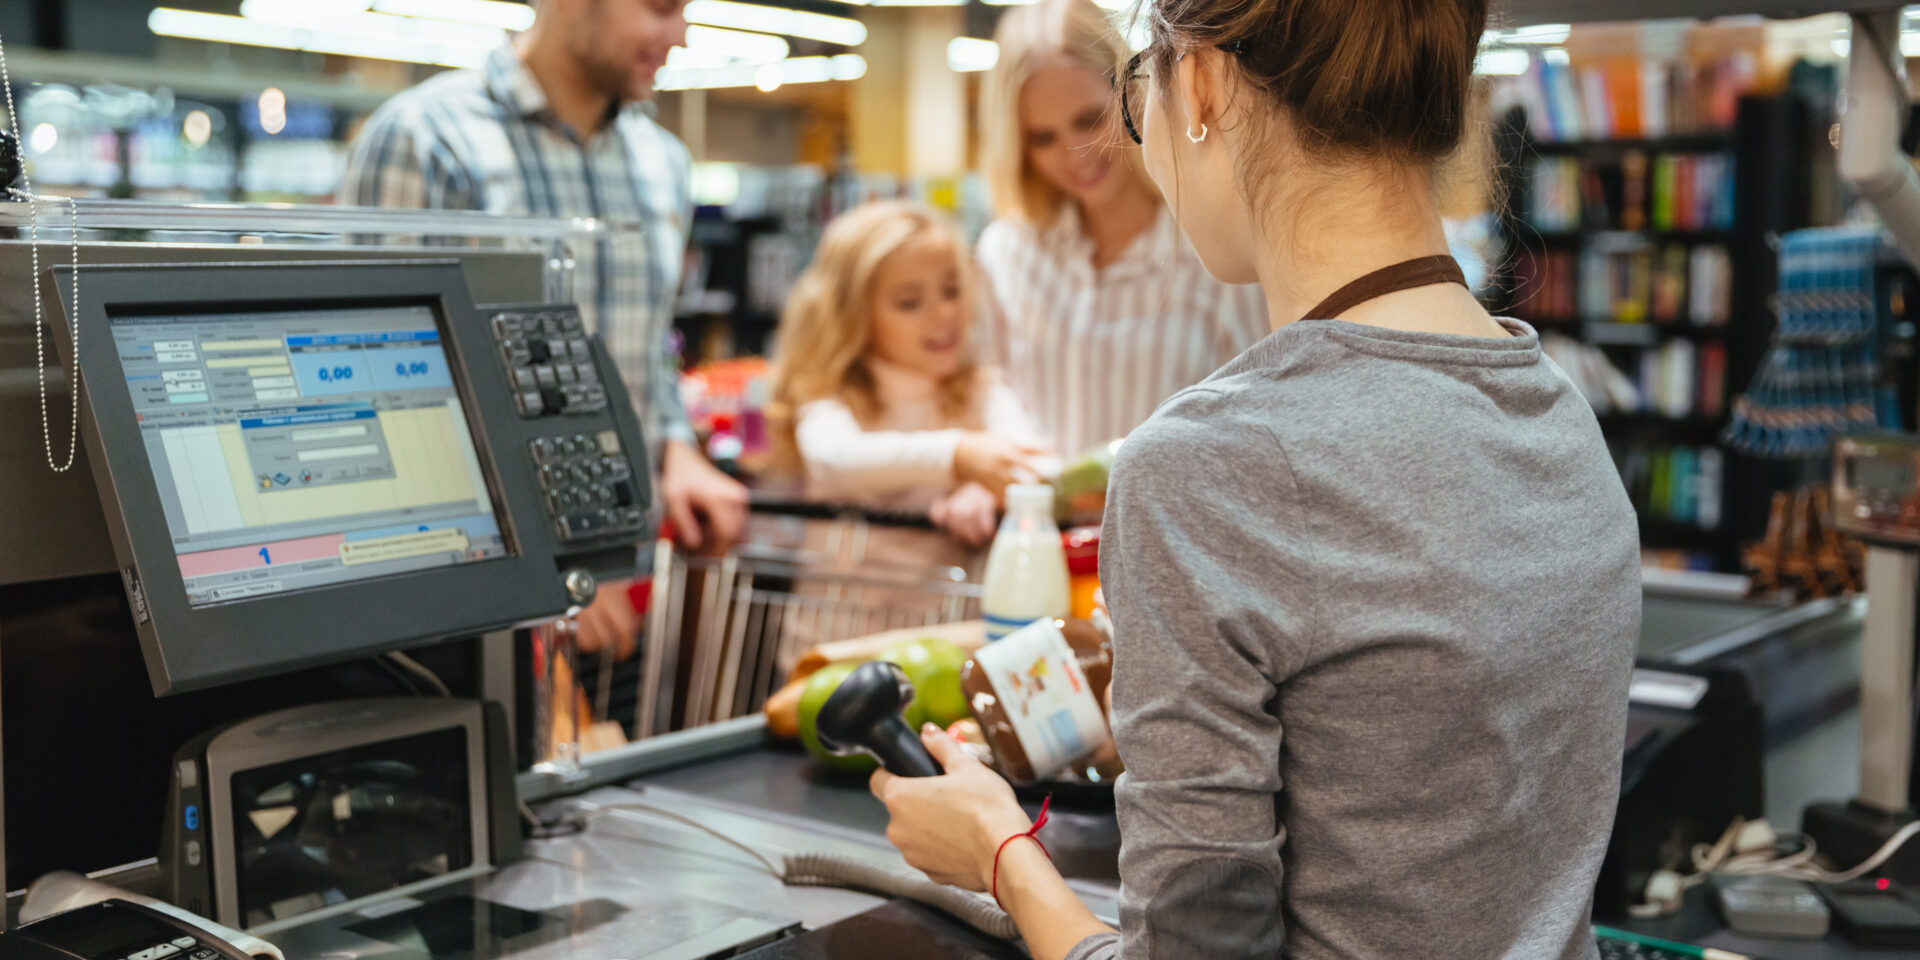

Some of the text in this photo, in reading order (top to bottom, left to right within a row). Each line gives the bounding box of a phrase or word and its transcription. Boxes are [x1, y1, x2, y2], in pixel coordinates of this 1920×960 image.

[318, 366, 353, 383] 0,00
[395, 361, 428, 378] 0,00
[258, 547, 271, 565] 1
